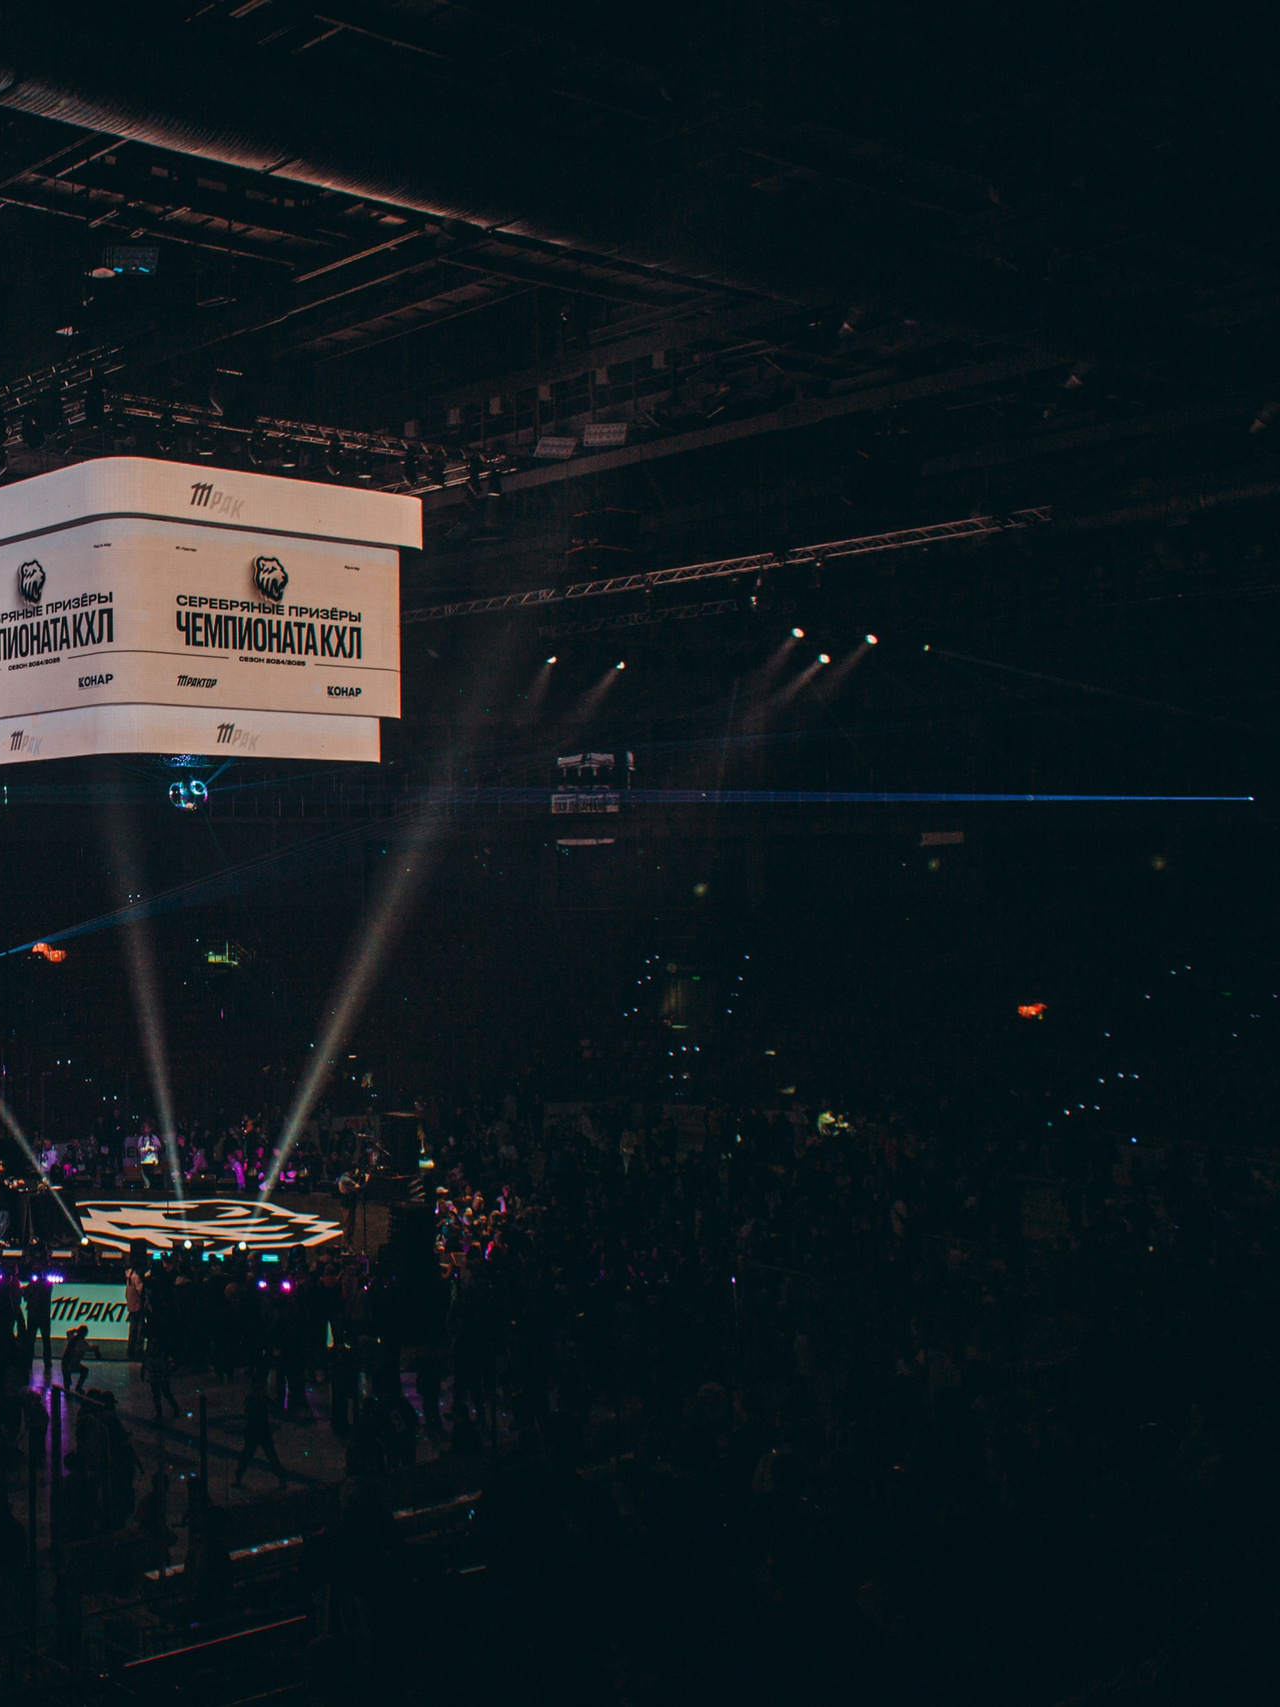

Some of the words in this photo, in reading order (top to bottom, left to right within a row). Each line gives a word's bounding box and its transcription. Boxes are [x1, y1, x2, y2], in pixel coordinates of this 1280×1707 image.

[46, 591, 113, 615] ПРИЗЁРЫ
[176, 594, 284, 616] СЕРЕБРЯНЫЕ
[288, 604, 362, 623] ПРИЗЁРЫ
[73, 607, 114, 648] КХЛ
[176, 610, 319, 656] ЧЕМПИОНАТА
[320, 624, 362, 659] КХЛ
[239, 656, 265, 664] СЕЗОН
[78, 674, 114, 688] КОНАР
[326, 686, 362, 697] КОНАР
